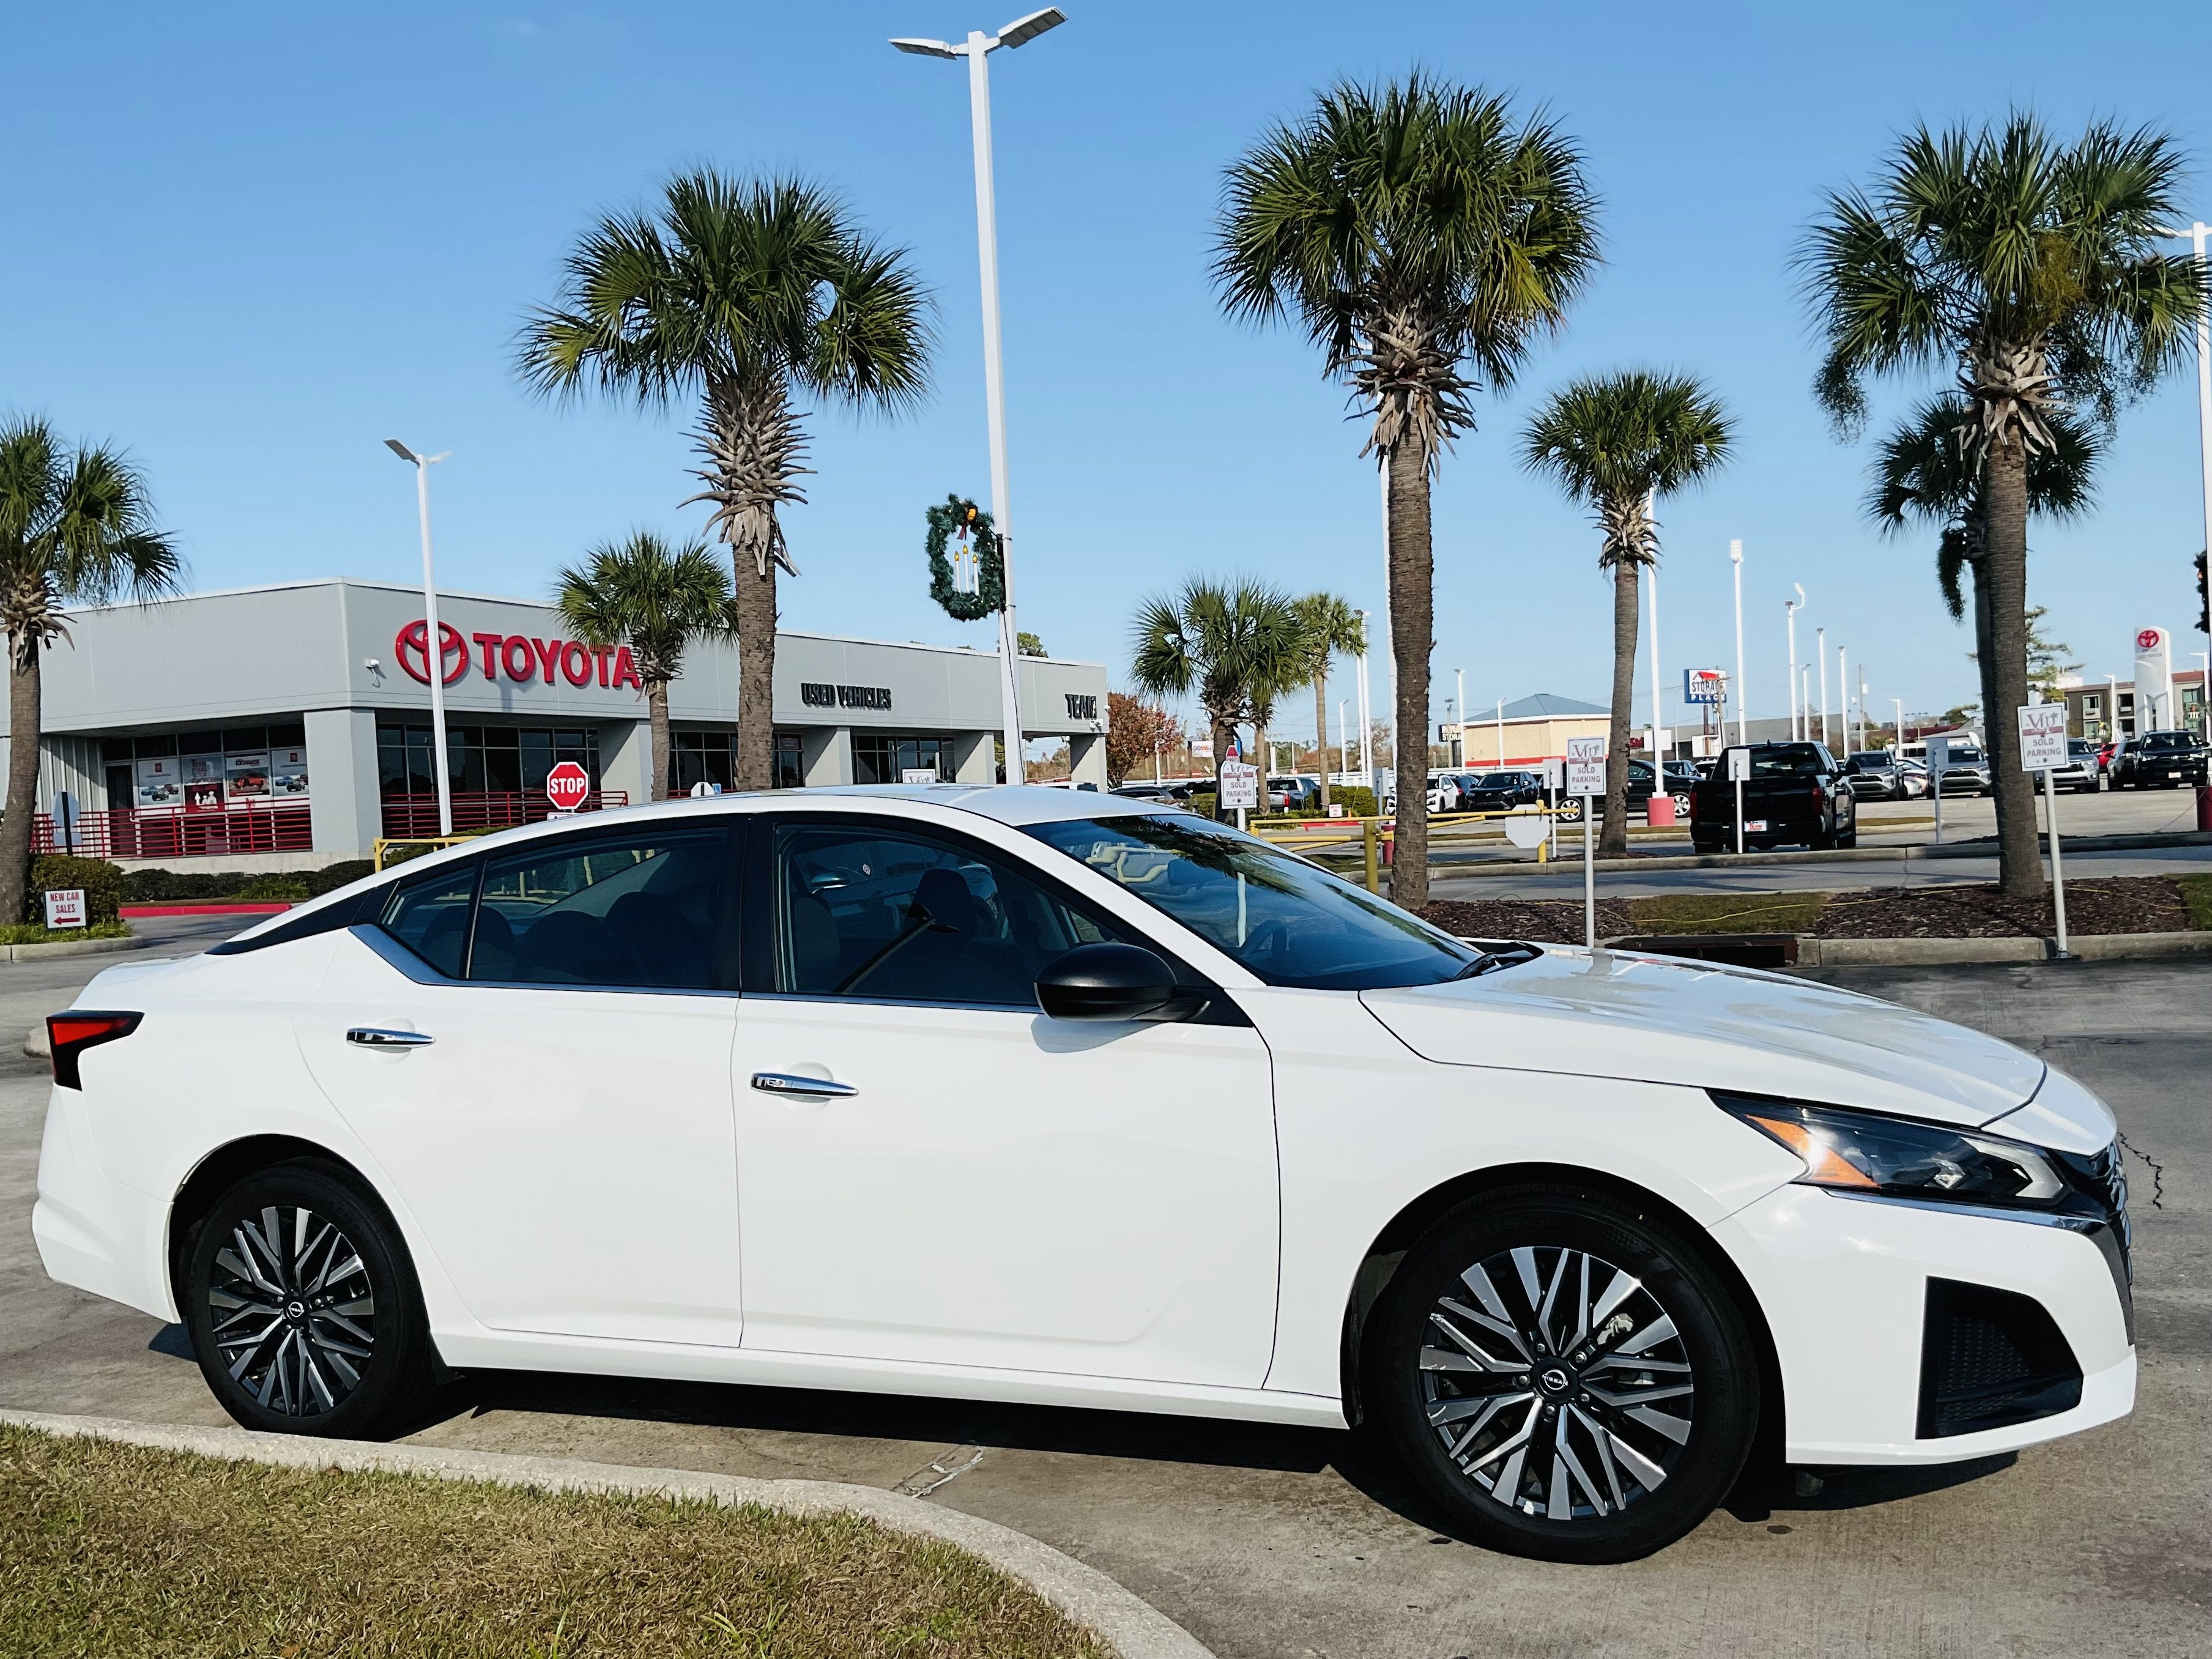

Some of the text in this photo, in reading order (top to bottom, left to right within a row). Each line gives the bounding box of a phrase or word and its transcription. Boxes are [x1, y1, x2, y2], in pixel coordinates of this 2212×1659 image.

[473, 633, 640, 688] TOYOTA
[801, 683, 891, 708] USED VEHICLES
[1065, 694, 1097, 718] TEAM
[2033, 738, 2054, 746] SOLD
[2027, 748, 2061, 757] PARKING
[551, 777, 585, 794] STOP
[50, 892, 80, 902] NEW CAR
[56, 904, 75, 913] SALES
